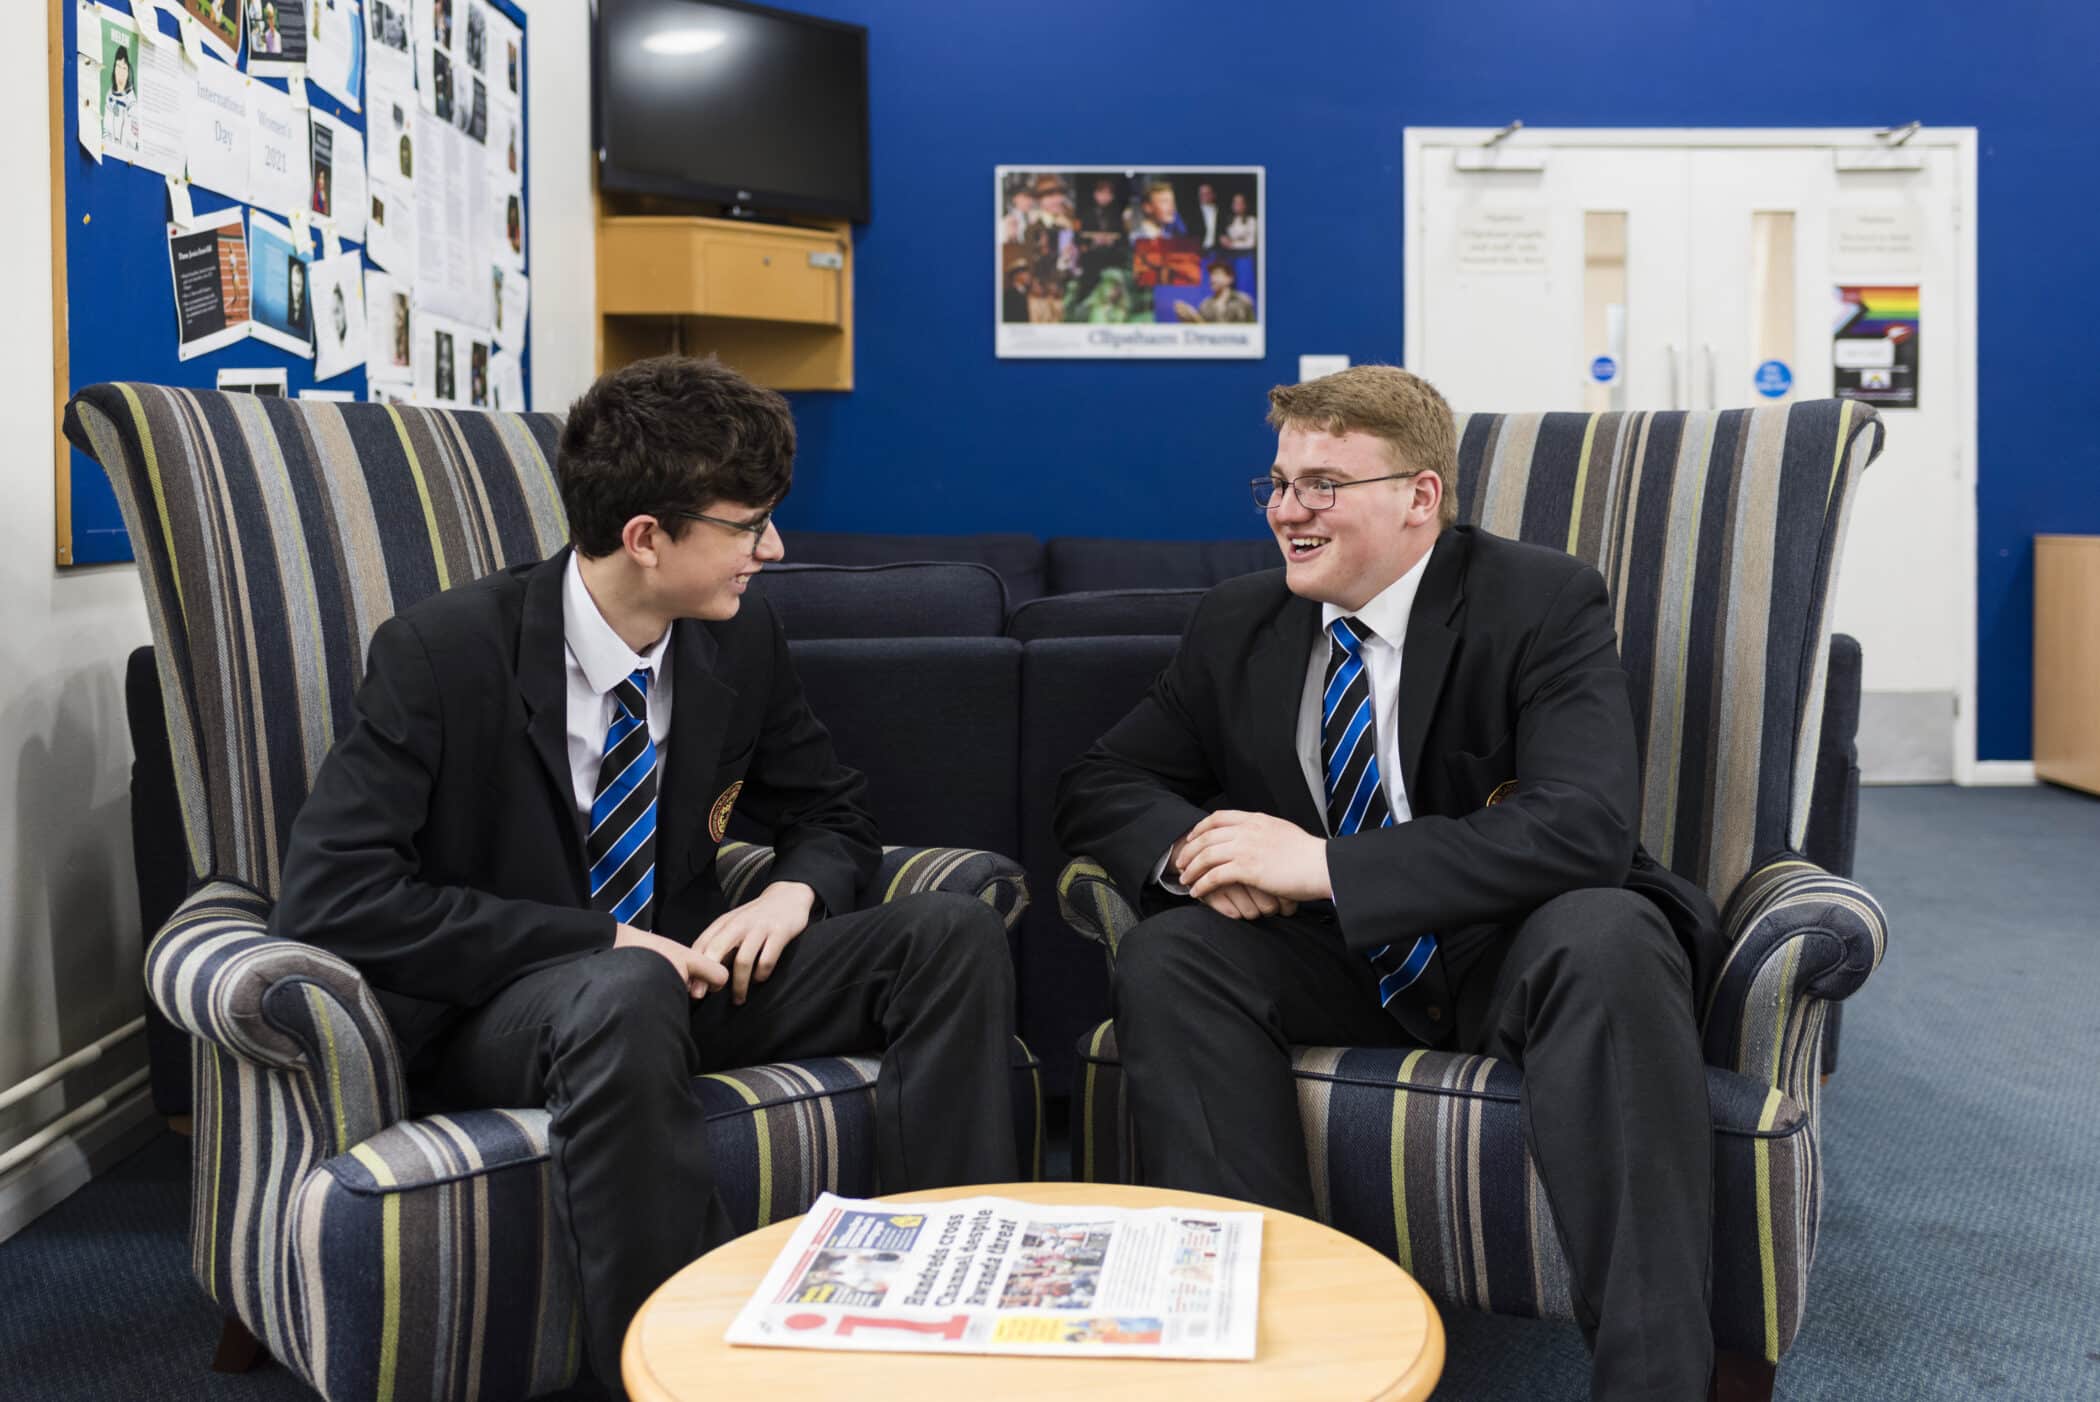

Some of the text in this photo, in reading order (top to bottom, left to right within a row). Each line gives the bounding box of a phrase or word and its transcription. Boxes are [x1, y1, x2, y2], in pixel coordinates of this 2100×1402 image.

[197, 80, 246, 117] International
[215, 120, 287, 173] Day 2021
[903, 1214, 965, 1306] Hundreds cross
[934, 1209, 993, 1306] Channel despite
[964, 1257, 1003, 1306] Rwanda
[986, 1219, 1018, 1255] threat
